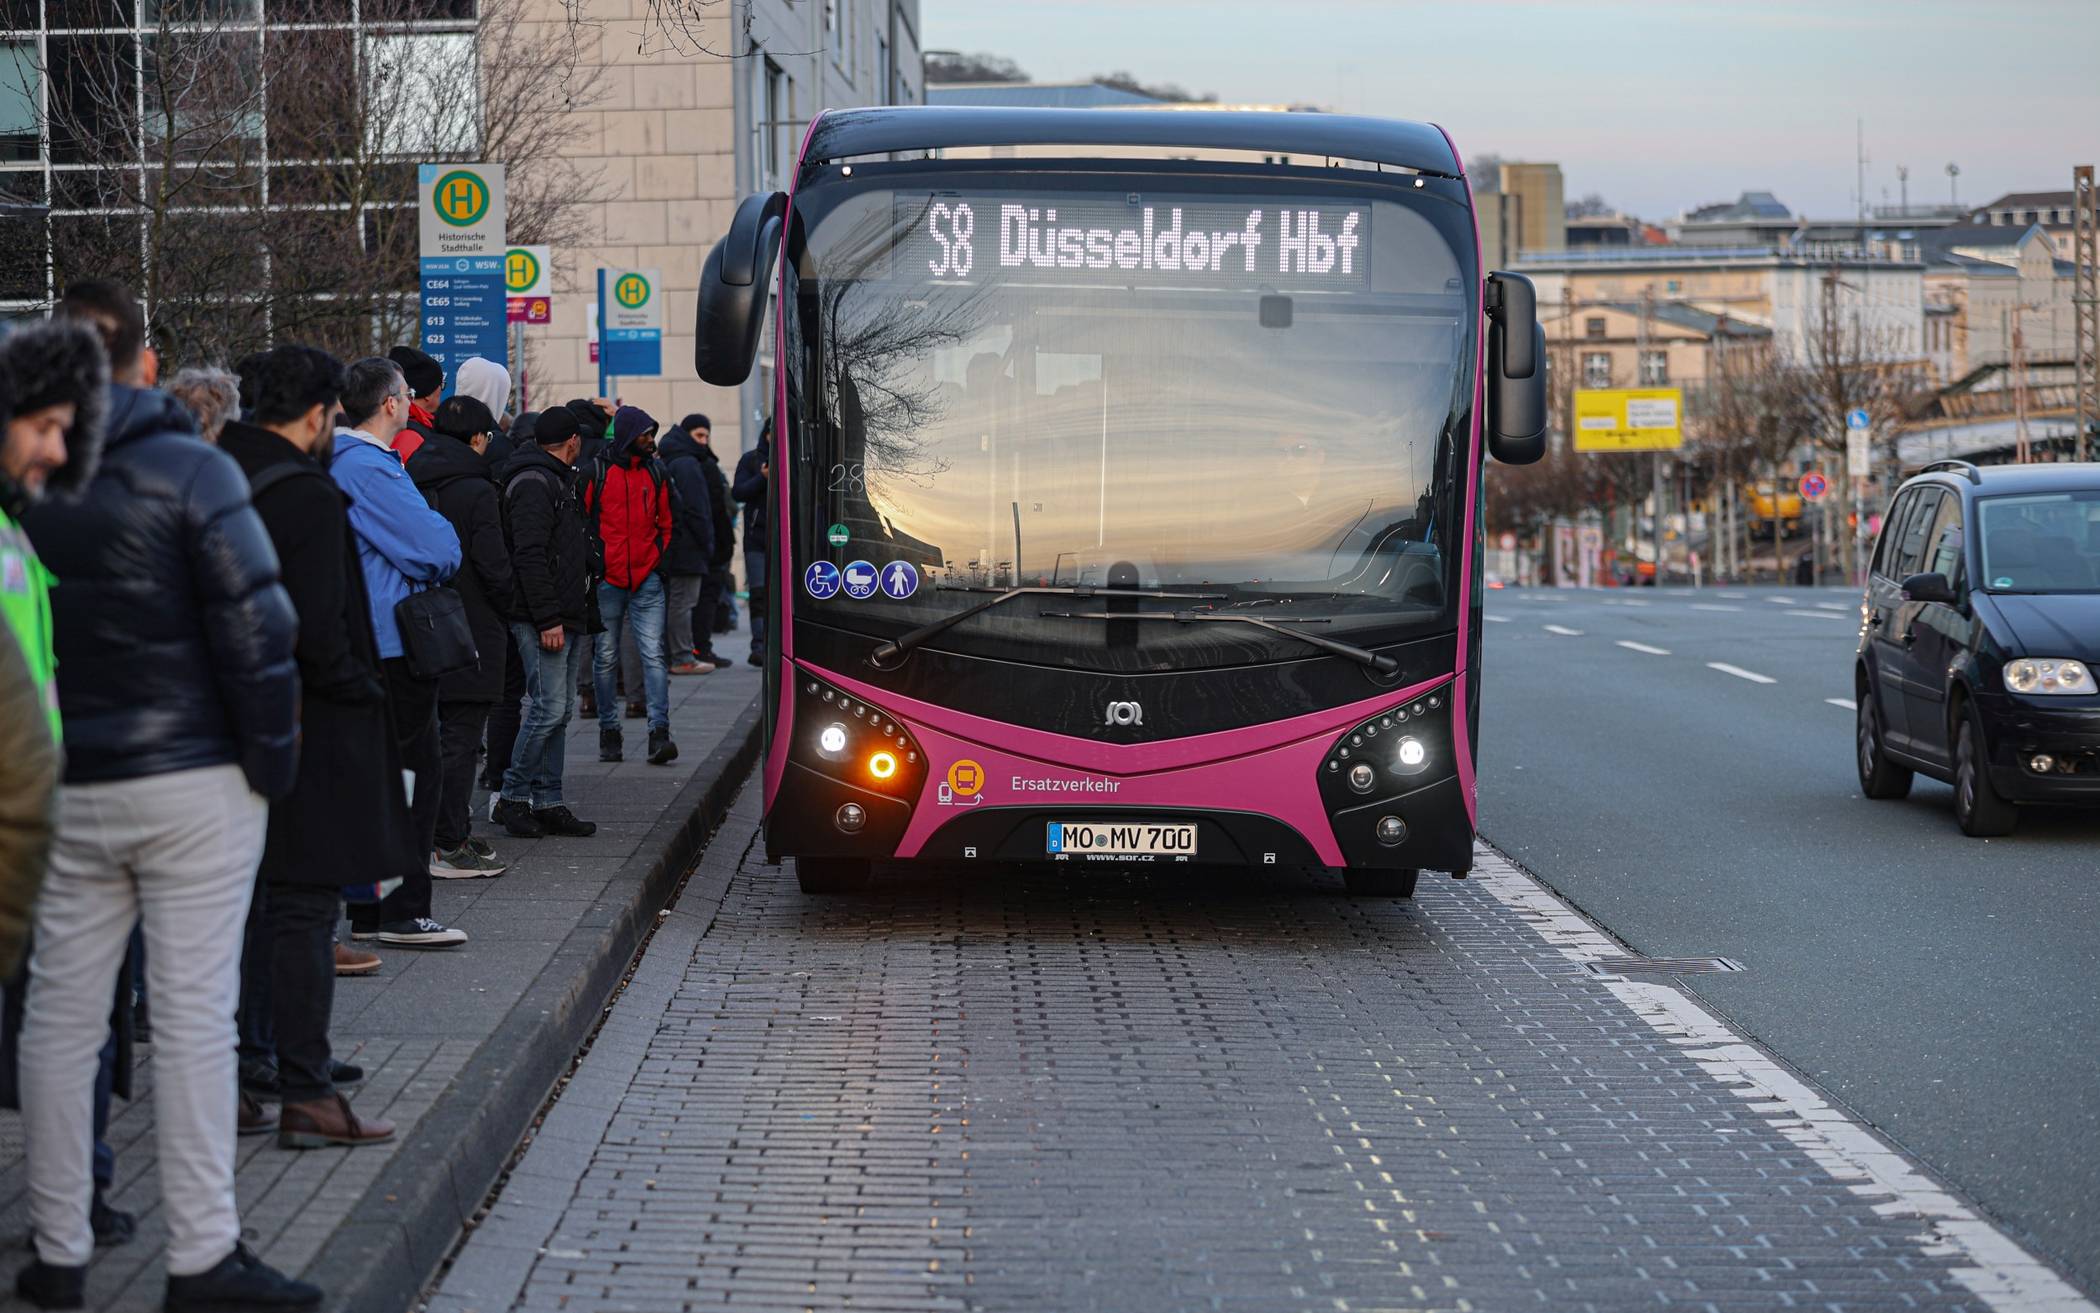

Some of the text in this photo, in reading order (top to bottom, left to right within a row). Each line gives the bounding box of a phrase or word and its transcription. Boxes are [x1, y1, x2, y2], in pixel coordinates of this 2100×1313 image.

[450, 184, 473, 214] H
[438, 232, 486, 241] Historische
[929, 203, 1359, 276] S8 Düsseldorf Hbf
[441, 243, 484, 253] Stadthalle
[509, 259, 527, 283] H
[426, 280, 450, 289] CE64
[625, 281, 640, 301] H
[426, 297, 450, 306] CE65
[427, 316, 445, 326] 613
[427, 334, 445, 344] 623
[429, 353, 445, 363] 35
[828, 464, 864, 493] 28
[1012, 776, 1121, 793] Ersatzverkehr
[1063, 827, 1192, 850] MO MV 700
[1086, 854, 1155, 862] www.sor.cz
